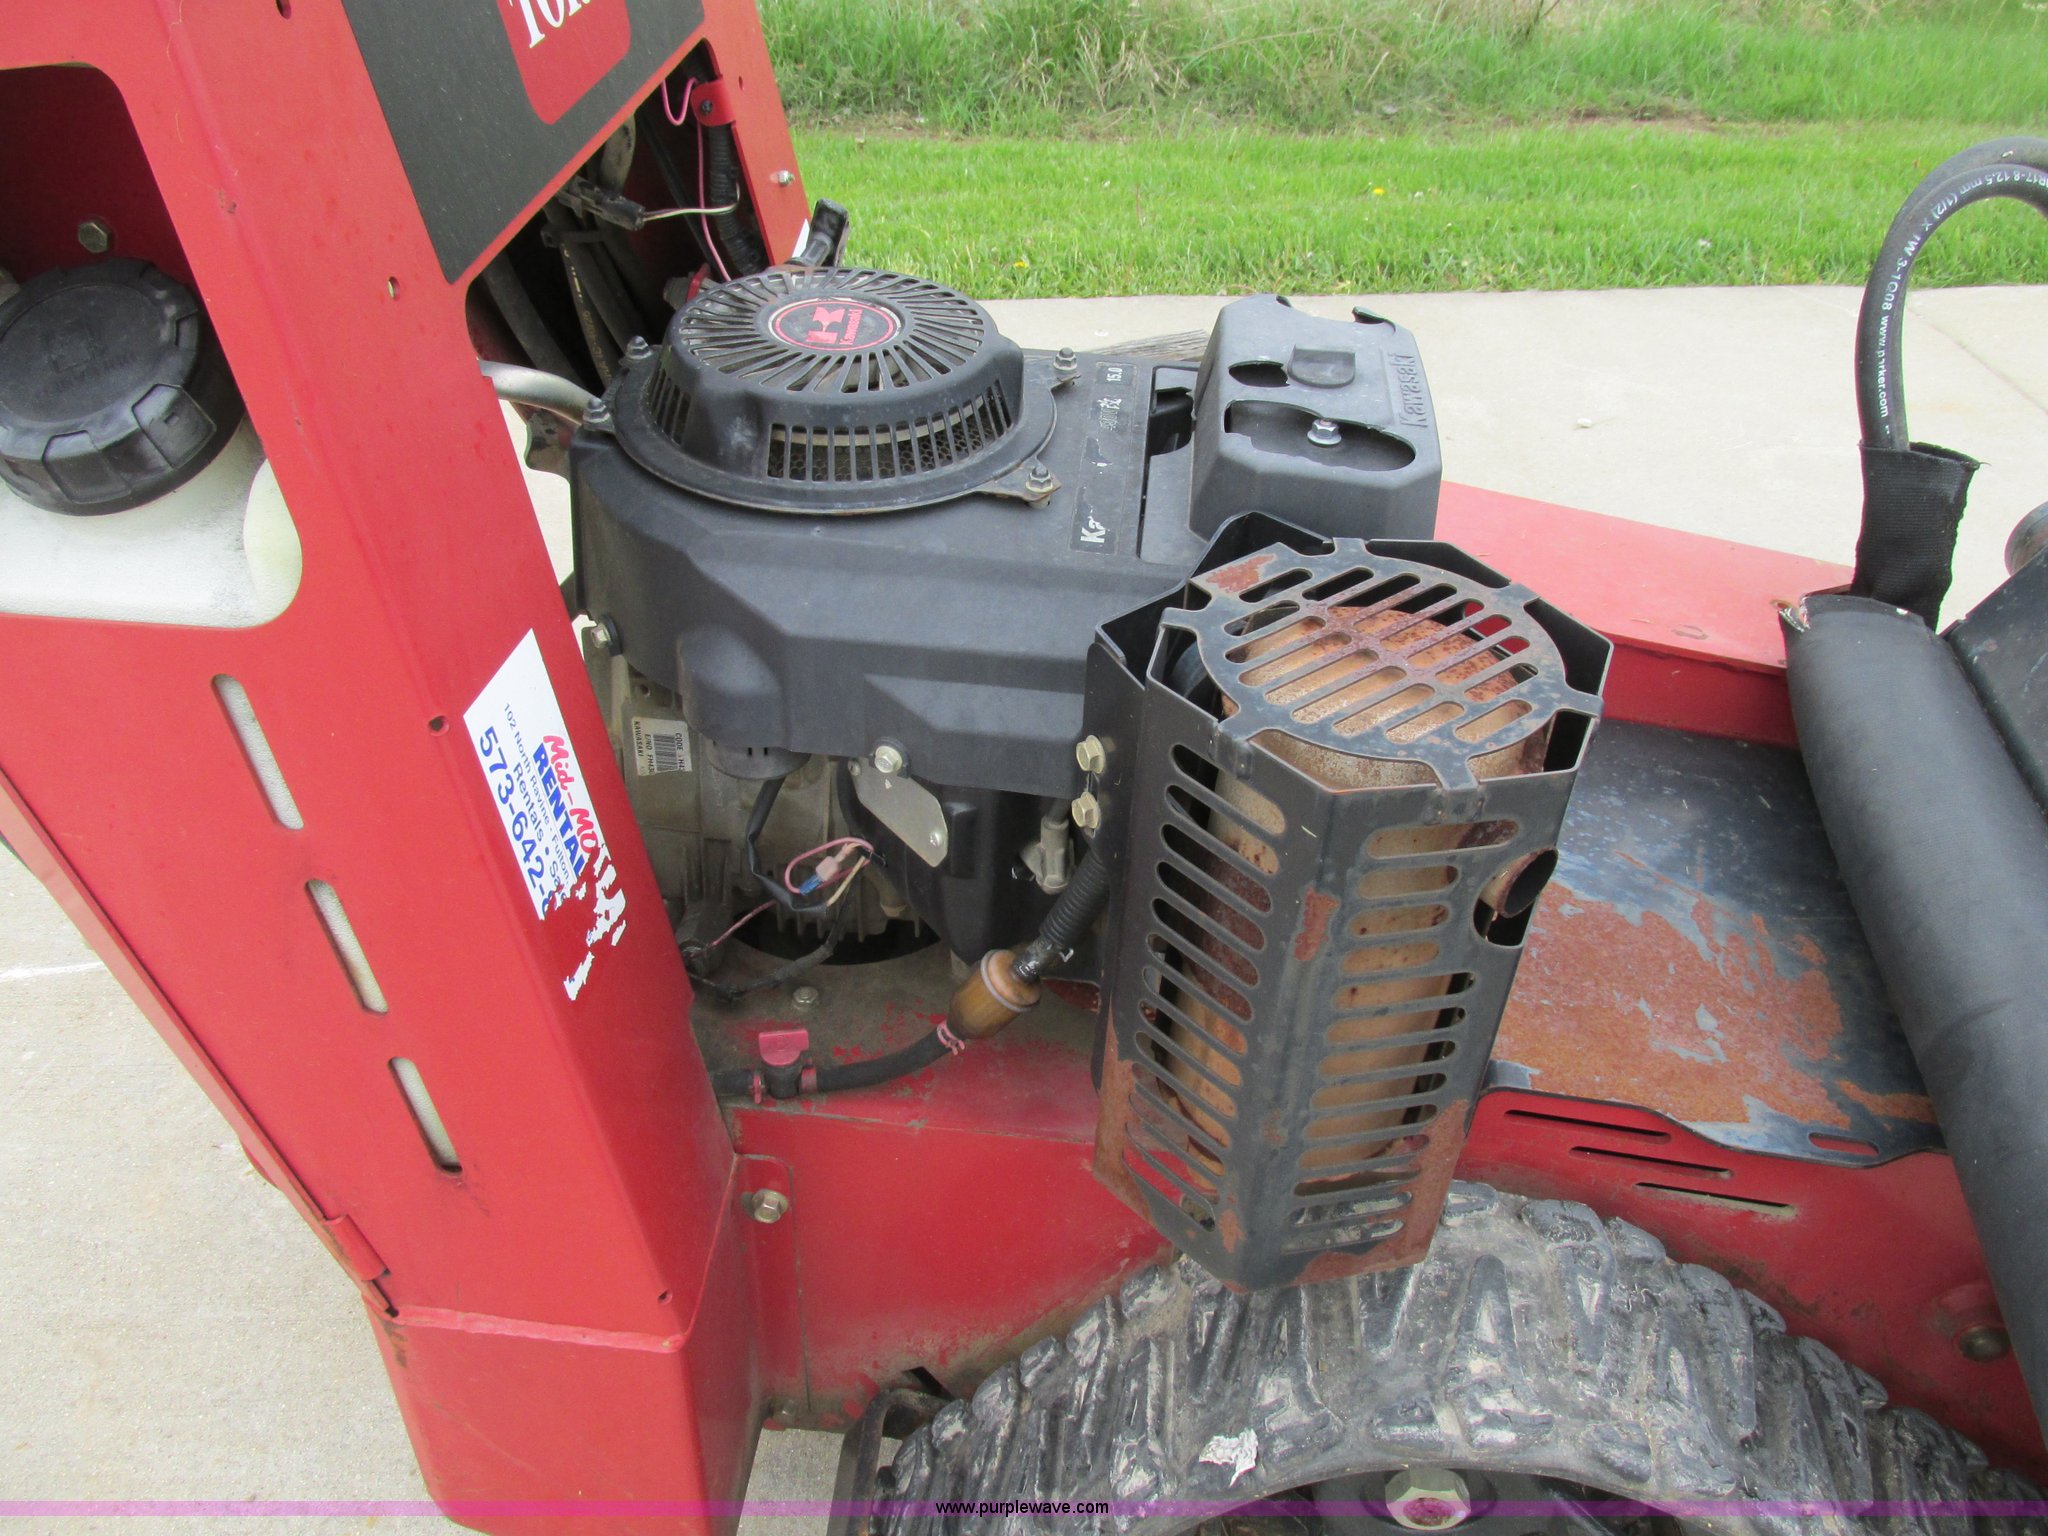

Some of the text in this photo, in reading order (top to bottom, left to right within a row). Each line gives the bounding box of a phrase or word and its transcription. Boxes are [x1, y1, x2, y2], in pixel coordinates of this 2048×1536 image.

[2013, 170, 2048, 189] R17-8
[839, 309, 863, 345] Kawasaki
[1106, 367, 1123, 382] 15.0
[1387, 352, 1428, 428] Kawasaki
[634, 720, 644, 757] KAWASAKI
[675, 732, 684, 751] CODE
[504, 703, 516, 729] 102
[514, 731, 531, 773] North
[530, 775, 550, 825] Ravine
[513, 762, 544, 842] Rentals
